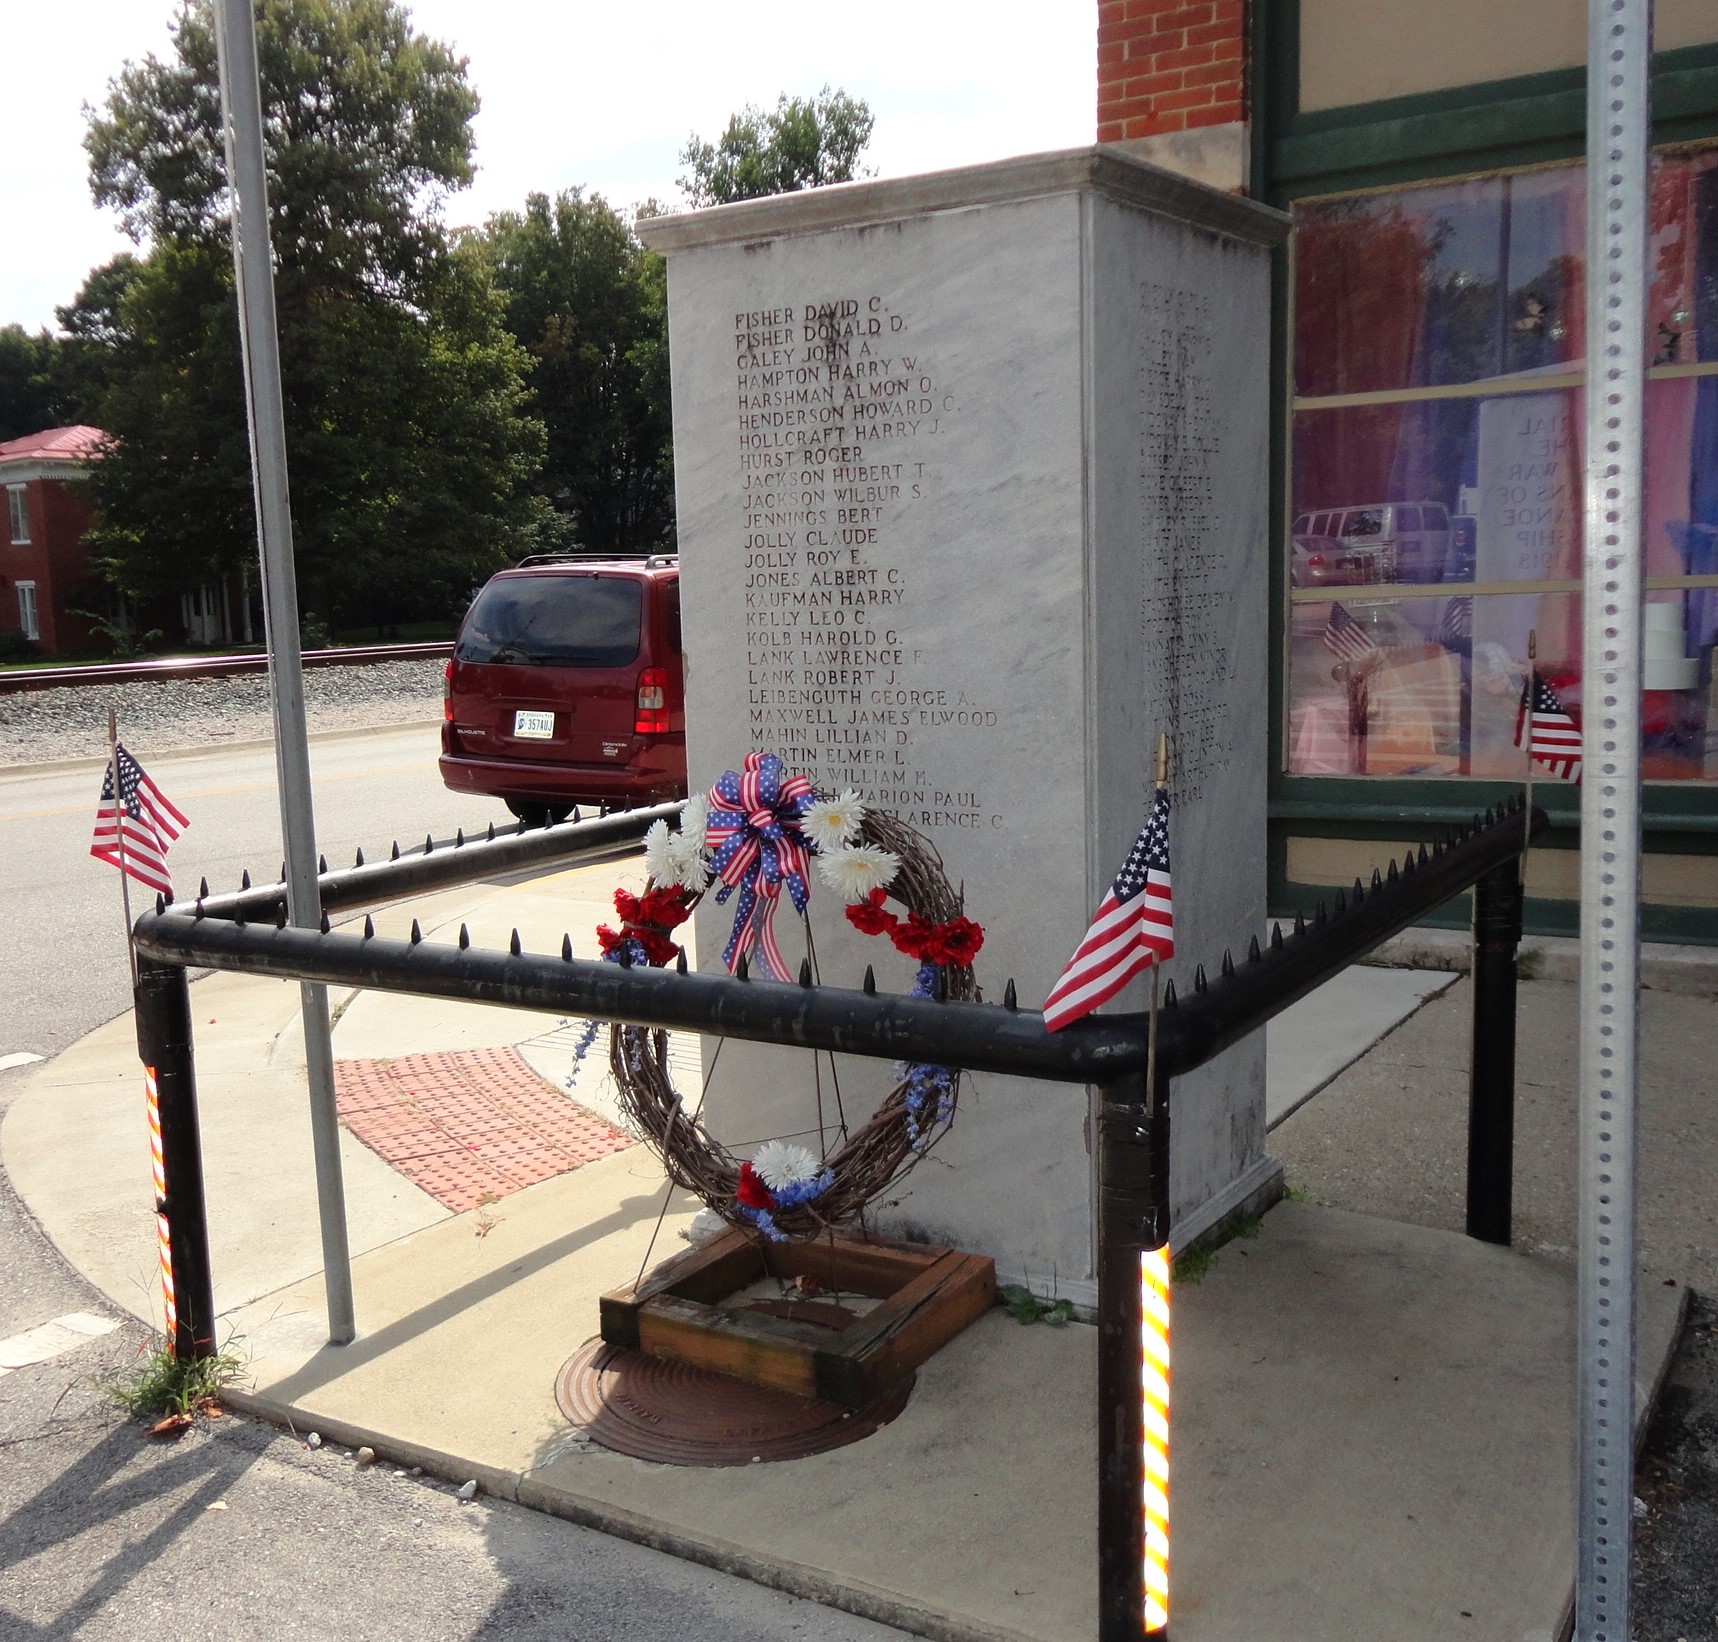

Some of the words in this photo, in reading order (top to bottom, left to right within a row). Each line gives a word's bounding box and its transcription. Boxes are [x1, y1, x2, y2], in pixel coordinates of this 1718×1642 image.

[735, 309, 794, 329] FISHER
[805, 300, 859, 322] DAVID
[869, 297, 888, 313] C.
[735, 329, 794, 350] FISHER
[804, 319, 881, 342] DONALD
[891, 316, 907, 332] D.
[803, 344, 849, 363] JOHN
[860, 342, 877, 357] A.
[738, 368, 819, 389] HAMPTON
[829, 360, 892, 381] HARRY
[902, 357, 921, 372] W.
[739, 387, 833, 409] HARSHMAN
[844, 380, 909, 401] ALMON
[920, 377, 937, 393] O.
[739, 407, 844, 429] HENDERSON
[854, 399, 932, 419] HOWARD
[943, 396, 960, 412] C.
[740, 427, 845, 450] HOLLCRAFT
[855, 421, 920, 441] HARRY
[929, 419, 944, 435] J.
[741, 451, 794, 470] HURST
[804, 447, 862, 464] ROGER
[743, 470, 824, 489] JACKSON
[833, 465, 902, 483] HUBERT
[743, 491, 824, 510] JACKSON
[834, 486, 900, 503] WILBUR
[912, 485, 927, 499] S.
[743, 510, 827, 528] JENNINGS
[838, 507, 883, 523] BERT
[744, 532, 796, 548] JOLLY
[807, 529, 877, 545] CLAUDE
[745, 553, 796, 568] JOLLY
[807, 552, 840, 566] ROY
[851, 550, 867, 564] E.
[746, 572, 800, 588] JONES
[810, 570, 877, 586] ALBERT
[887, 569, 905, 584] C.
[746, 592, 832, 607] KAUFMAN
[841, 590, 904, 605] HARRY
[746, 612, 799, 626] KELLY
[810, 611, 845, 626] LEO
[854, 611, 870, 625] C.
[747, 631, 792, 645] KOLB
[801, 631, 876, 645] HAROLD
[886, 631, 903, 644] G.
[748, 651, 794, 665] LANK
[803, 650, 902, 665] LAWRENCE
[749, 670, 795, 685] LANK
[804, 670, 874, 685] ROBERT
[886, 671, 901, 685] J.
[749, 690, 862, 704] LEIBENGUTH
[871, 690, 946, 705] GEORGE
[958, 691, 975, 706] A.
[750, 709, 837, 724] MAXWELL
[848, 710, 909, 725] JAMES
[920, 711, 997, 726] ELWOOD
[750, 729, 807, 743] MAHIN
[816, 730, 886, 744] LILLIAN
[896, 730, 913, 745] D.
[751, 748, 817, 763] RTIN
[827, 749, 885, 764] ELMER
[895, 750, 910, 765] L.
[780, 767, 817, 782] RTIN
[828, 768, 905, 784] WILLIAM
[934, 791, 980, 807] PAUL
[992, 815, 1008, 830] C.
